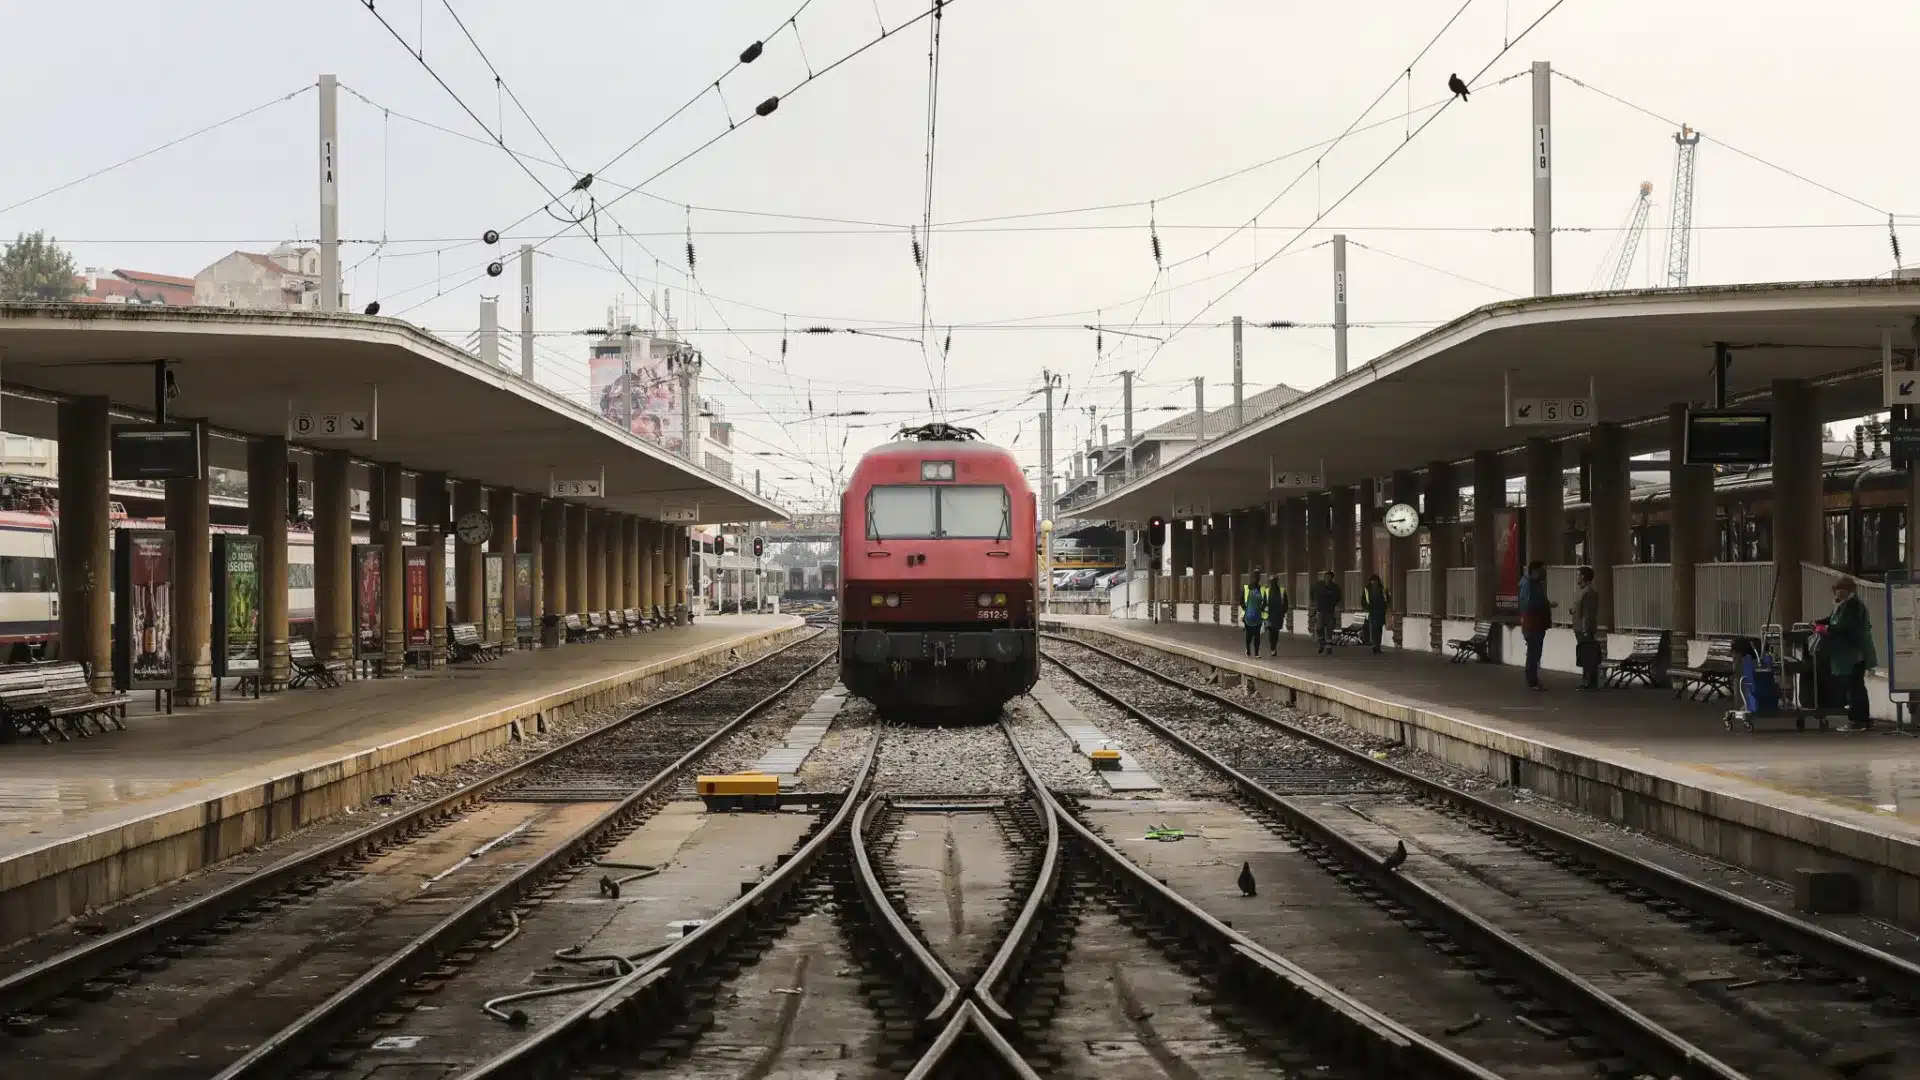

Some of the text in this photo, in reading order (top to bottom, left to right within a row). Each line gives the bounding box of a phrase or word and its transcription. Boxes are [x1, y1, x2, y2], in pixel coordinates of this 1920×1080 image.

[1548, 404, 1584, 419] 5 D
[299, 419, 335, 432] D 3
[574, 485, 579, 493] 3
[977, 610, 1009, 619] 5612-5
